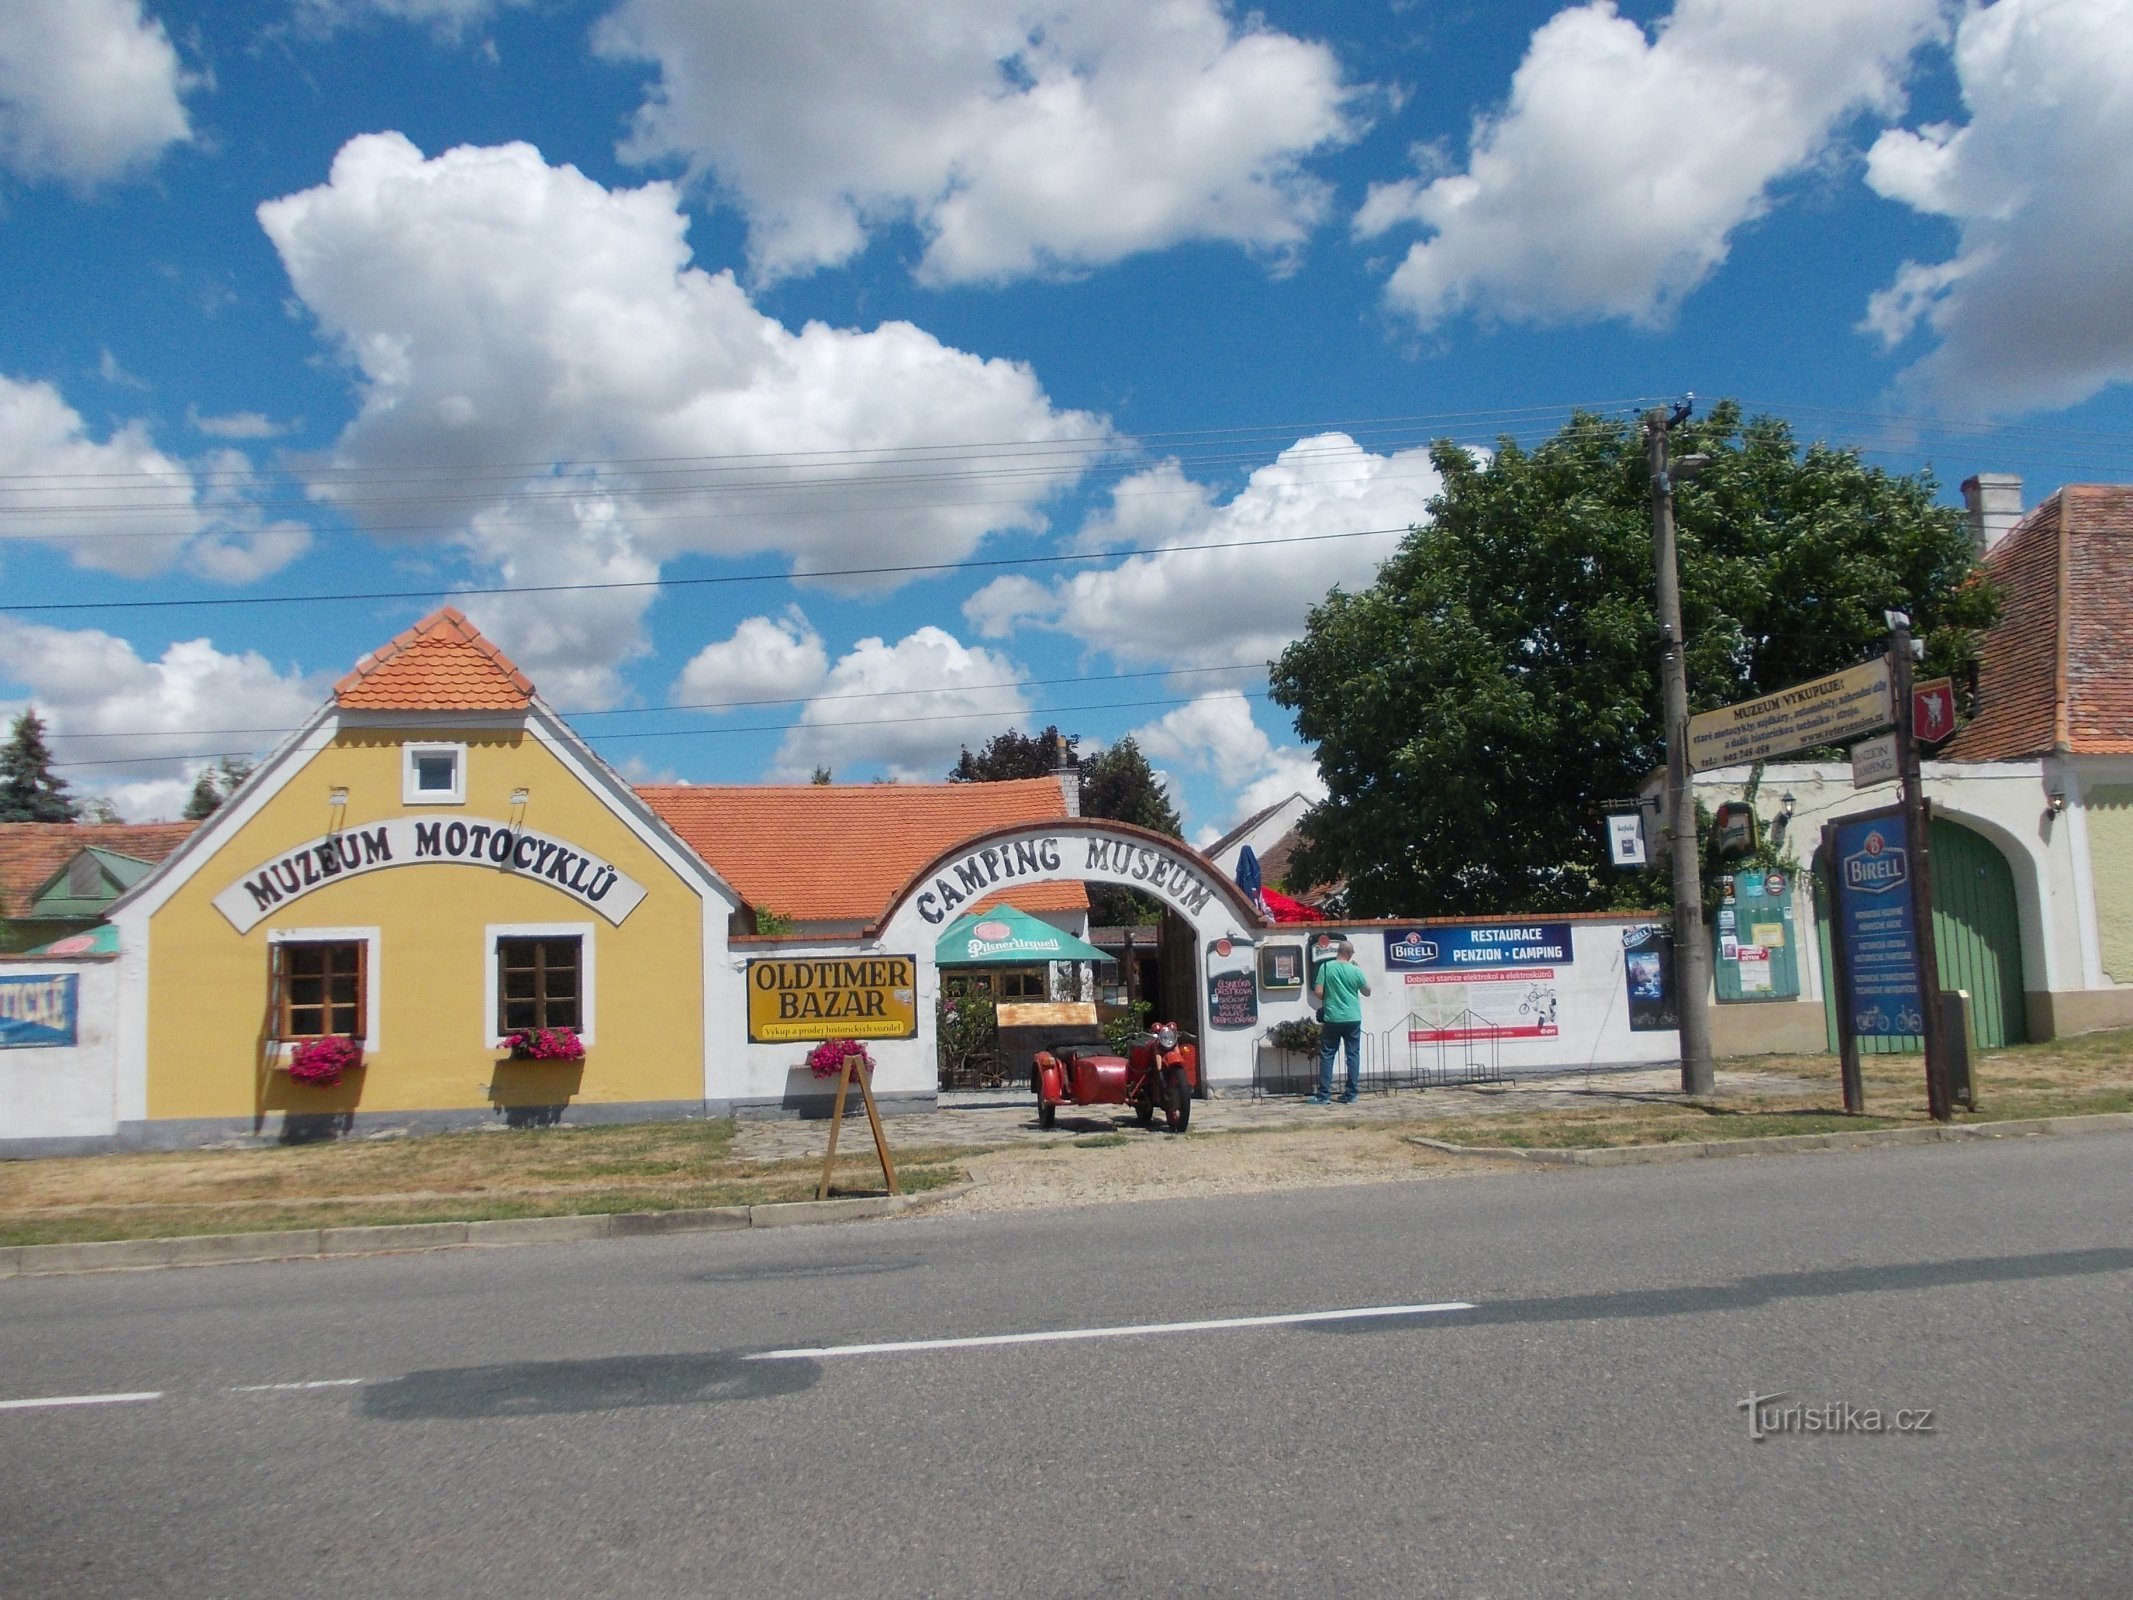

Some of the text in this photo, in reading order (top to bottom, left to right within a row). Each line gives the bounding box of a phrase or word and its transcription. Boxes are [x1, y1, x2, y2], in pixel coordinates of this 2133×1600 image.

[1734, 679, 1845, 721] MUZEUM VYKUPUJE:
[1855, 757, 1893, 778] AMPING
[244, 821, 618, 911] MUZEUM MOTOCYKLŮ
[1851, 859, 1903, 882] BIRELL
[916, 837, 1216, 924] CAMPING MUSEUM
[1471, 928, 1543, 942] RESTAURACE
[1623, 927, 1650, 947] BIRELL
[968, 938, 1059, 957] Pilsner Urquell
[1395, 945, 1434, 957] BIRELL
[1453, 946, 1562, 962] PENZION CAMPING
[755, 960, 910, 991] OLDTIMER
[778, 989, 888, 1019] BAZAR
[799, 1026, 825, 1036] prodej
[872, 1023, 901, 1032] vozidel
